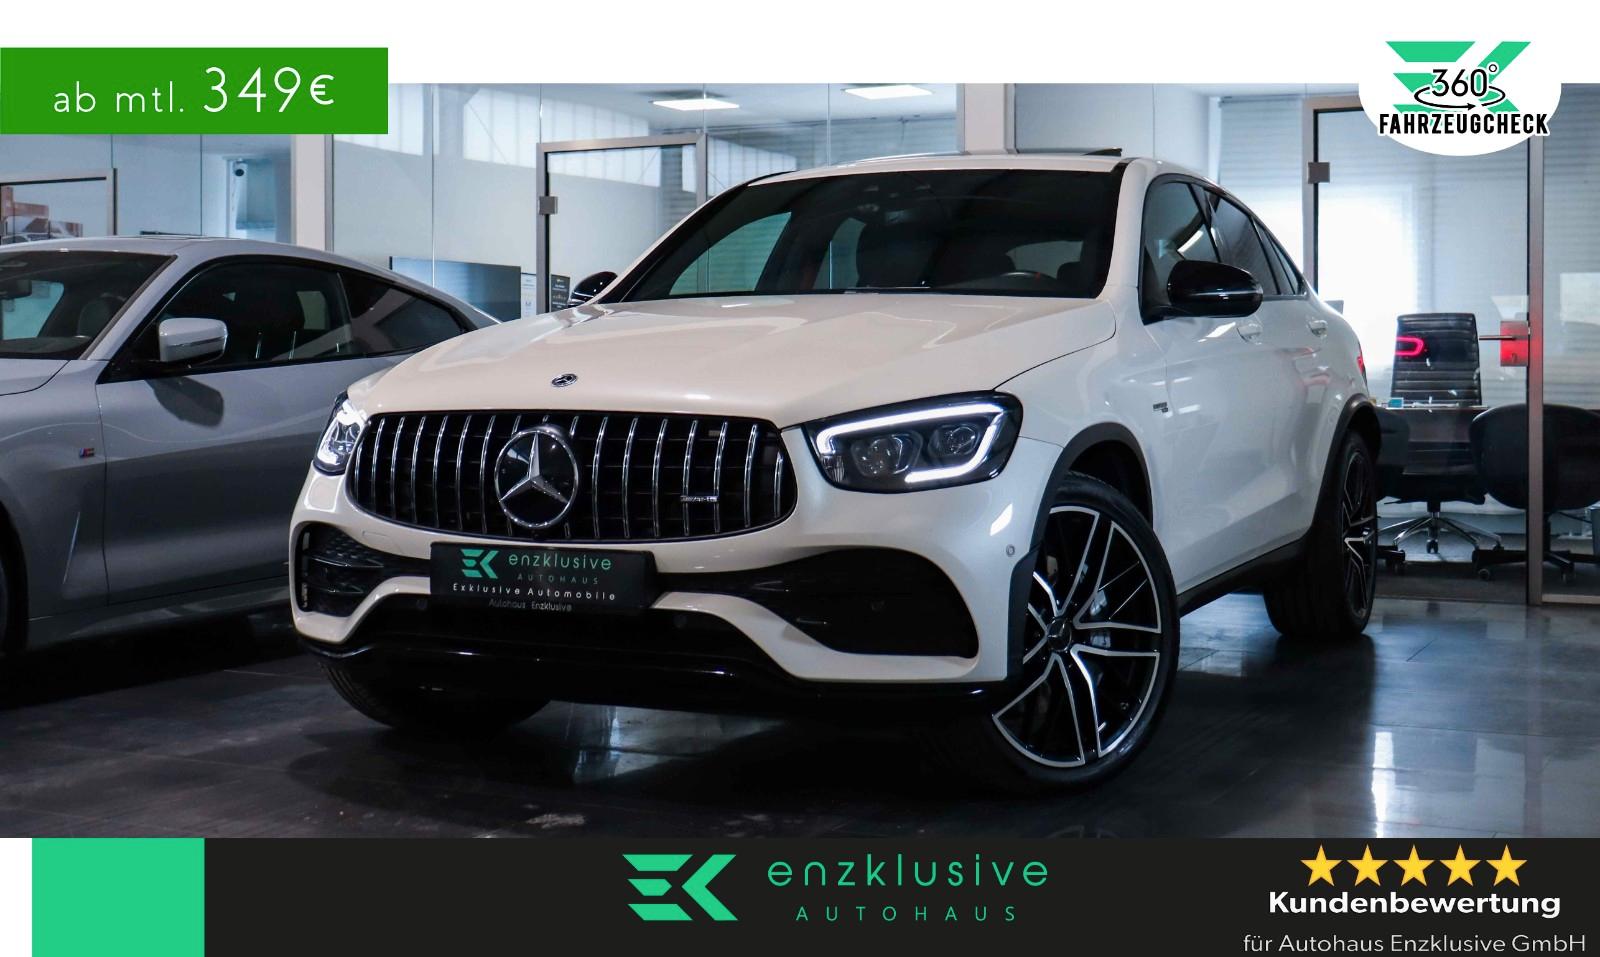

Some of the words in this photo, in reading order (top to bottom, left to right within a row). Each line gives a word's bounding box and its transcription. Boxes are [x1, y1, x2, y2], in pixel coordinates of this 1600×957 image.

[508, 553, 613, 571] enzklusive
[517, 573, 599, 585] AUTOHAUS
[452, 583, 520, 595] Exklusive
[527, 588, 616, 601] Automobile
[489, 598, 526, 610] Autohaus
[531, 600, 573, 612] Enzklusive
